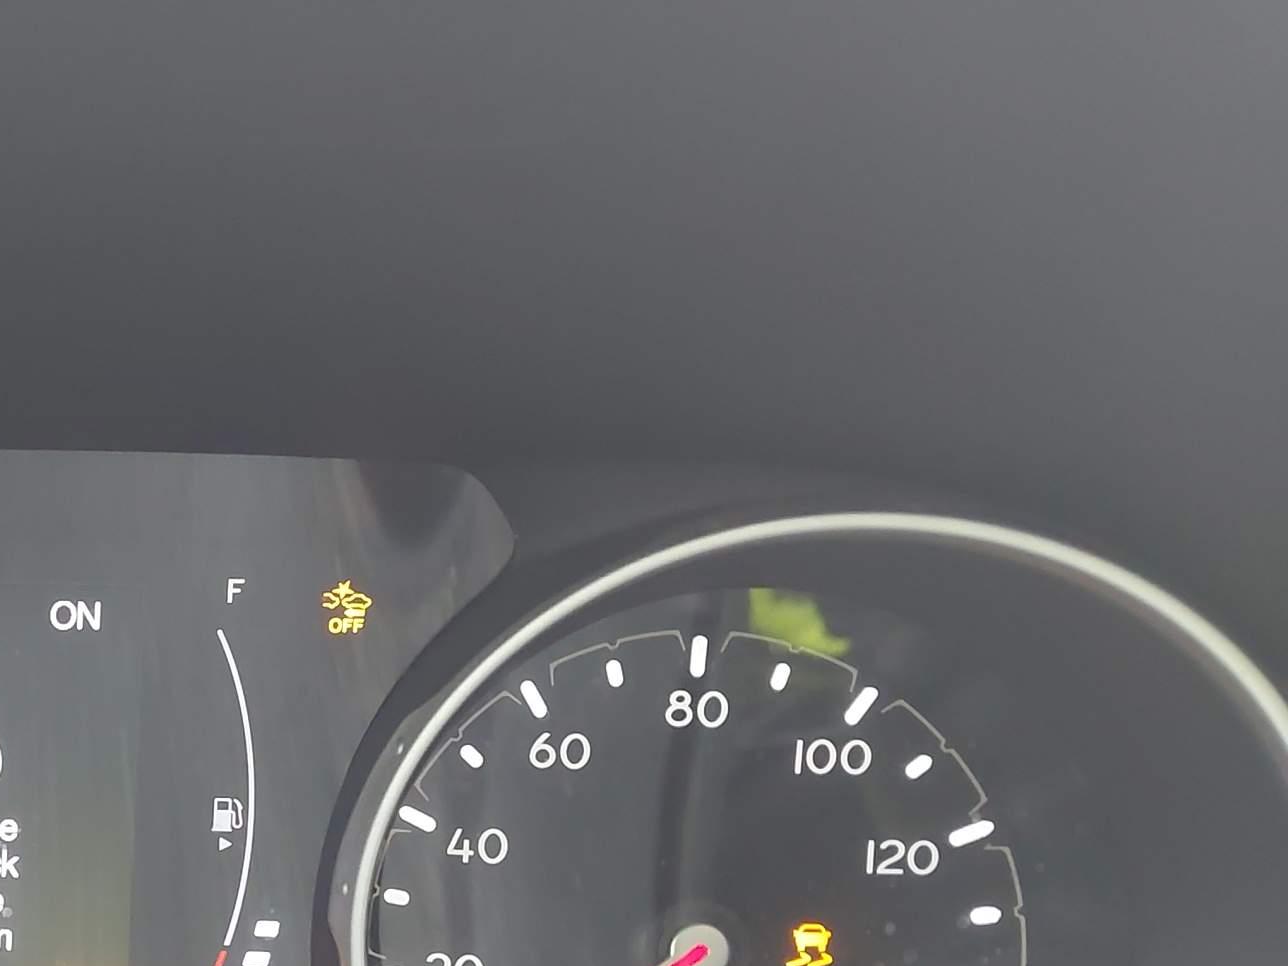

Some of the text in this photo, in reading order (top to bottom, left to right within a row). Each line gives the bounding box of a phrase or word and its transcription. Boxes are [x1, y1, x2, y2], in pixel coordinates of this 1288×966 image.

[226, 578, 246, 604] F
[49, 600, 102, 631] ON
[327, 617, 366, 635] OFF
[664, 690, 729, 729] 80
[529, 732, 591, 770] 60
[794, 738, 872, 776] 100
[446, 828, 509, 865] 40
[866, 839, 940, 876] 120
